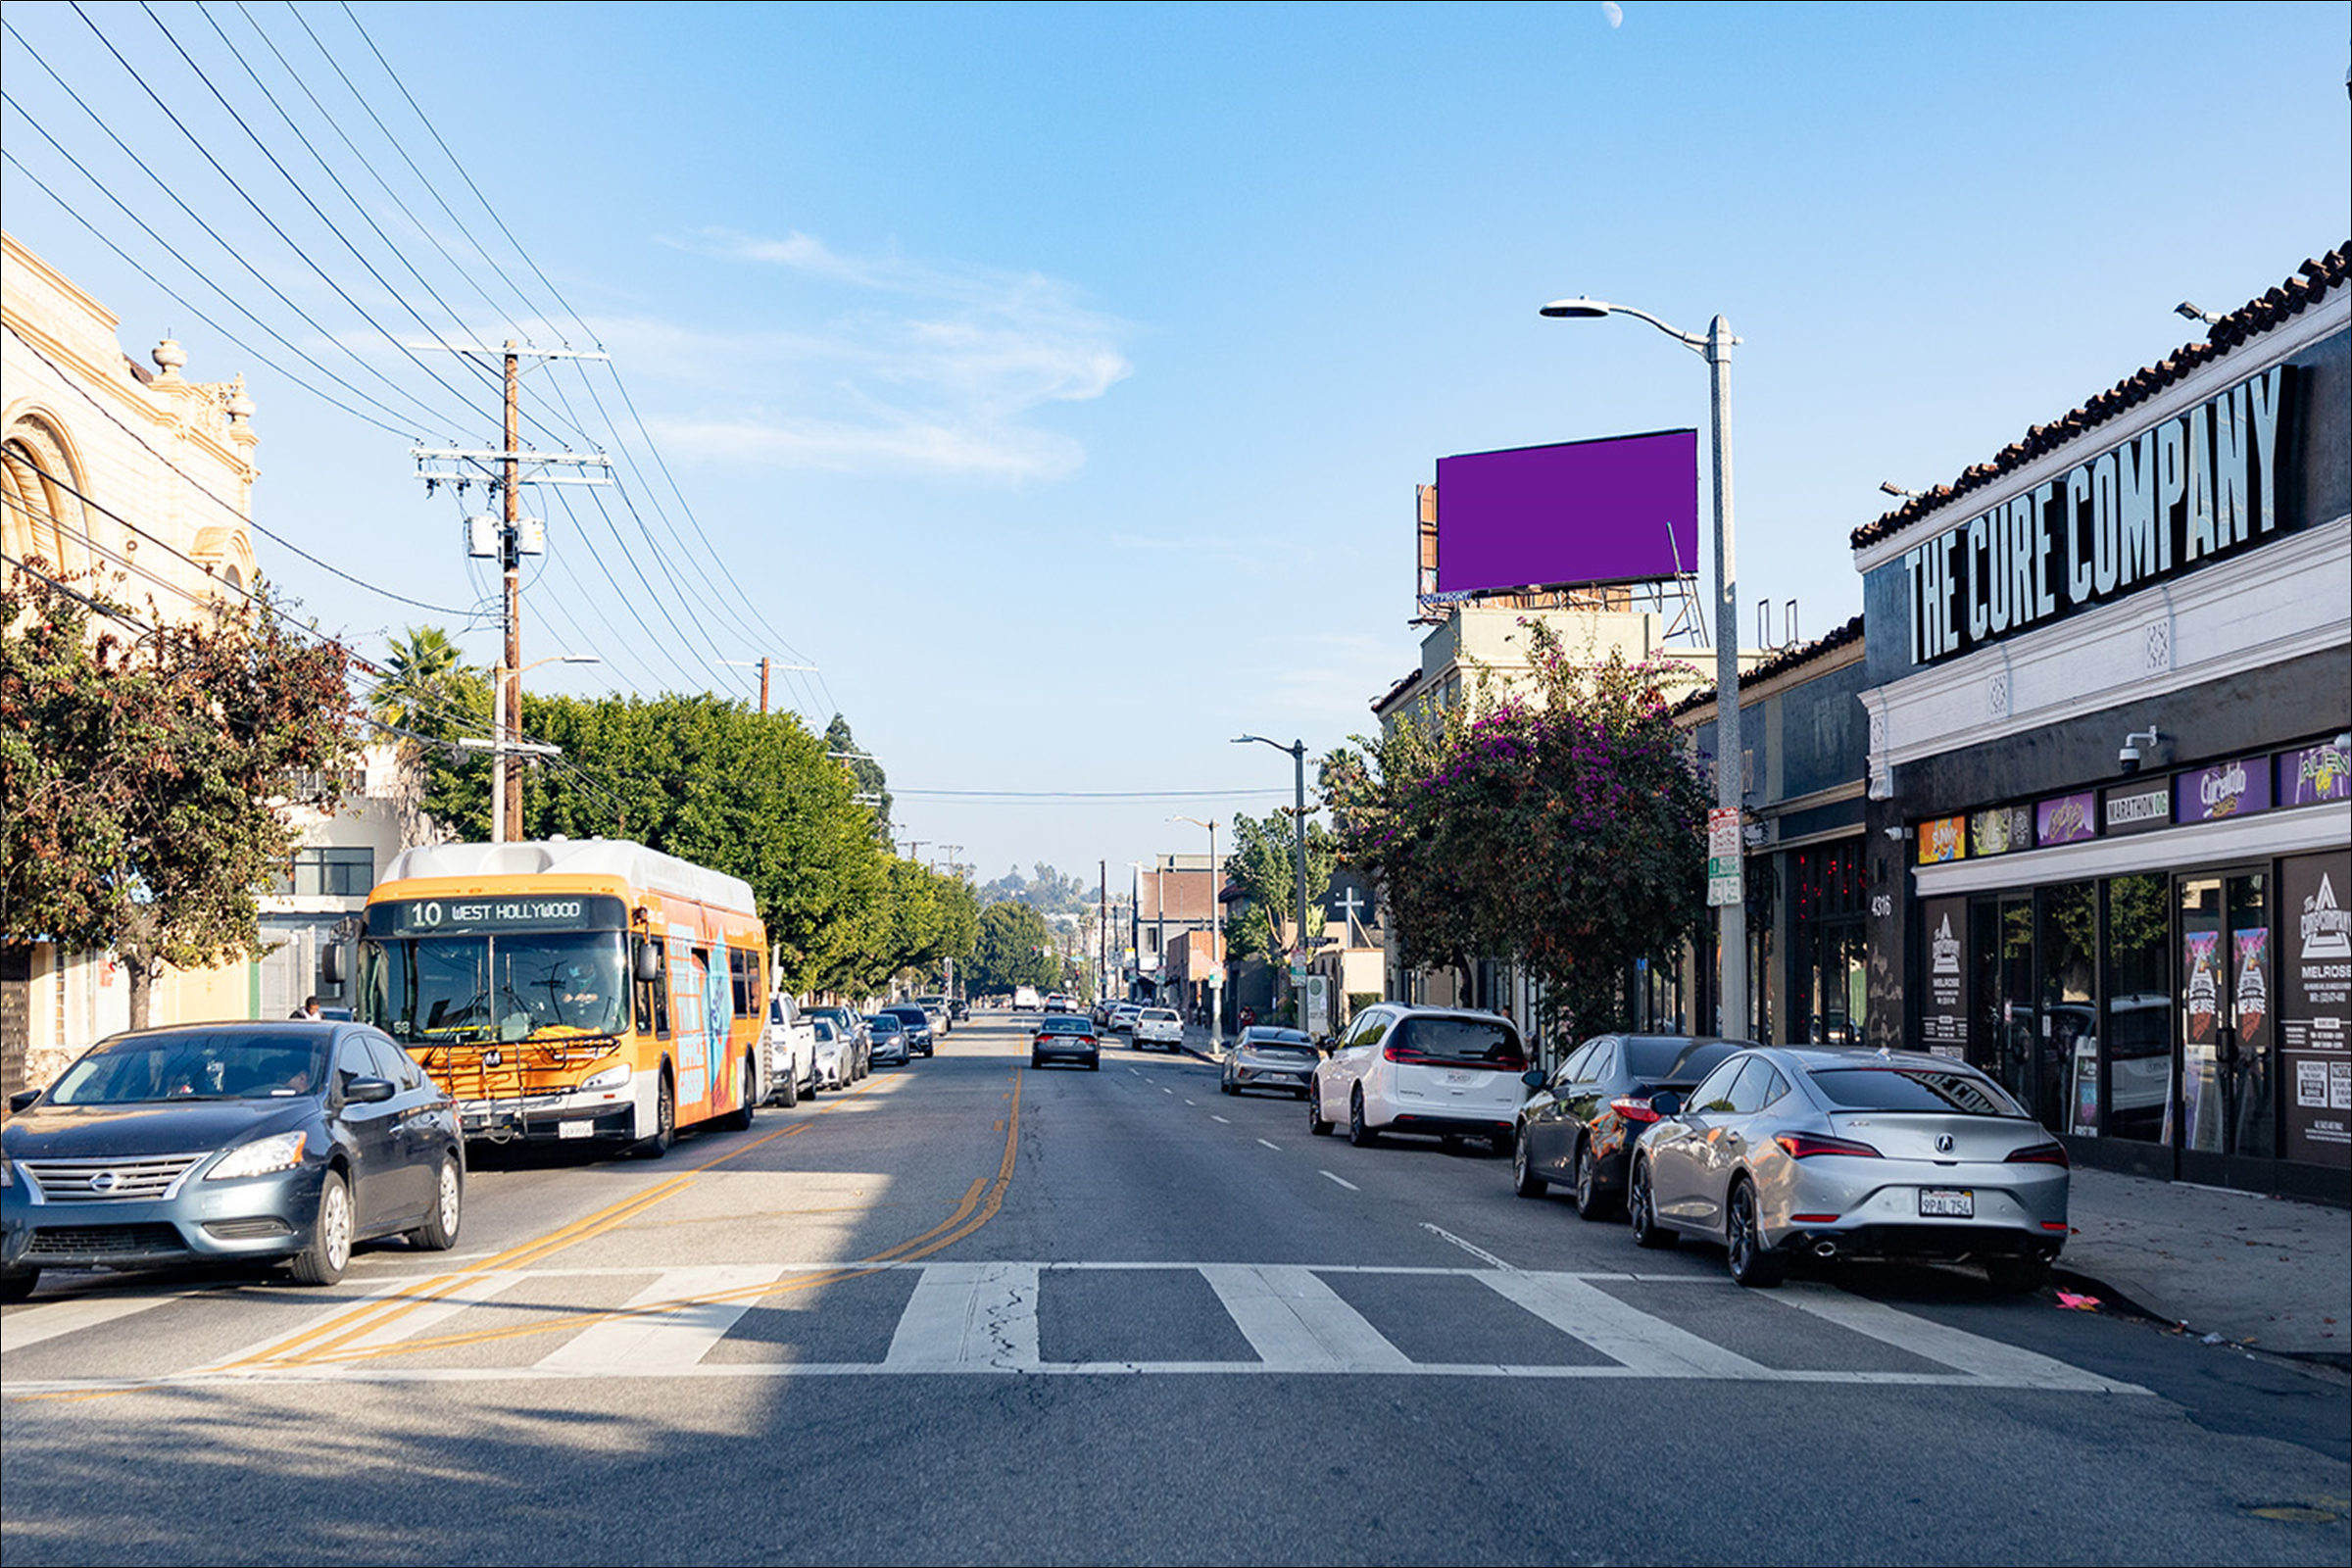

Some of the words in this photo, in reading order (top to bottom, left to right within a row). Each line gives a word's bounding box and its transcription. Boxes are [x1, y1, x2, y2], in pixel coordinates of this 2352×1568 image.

[1905, 530, 1959, 665] THE
[1967, 481, 2055, 643] CURE
[2066, 364, 2285, 605] COMPANY
[2108, 795, 2155, 823] MARATHON
[2155, 792, 2168, 815] OG
[412, 902, 442, 927] 10
[452, 904, 492, 920] WEST
[496, 902, 580, 919] HOLLYWOOD
[1871, 895, 1892, 917] 4316
